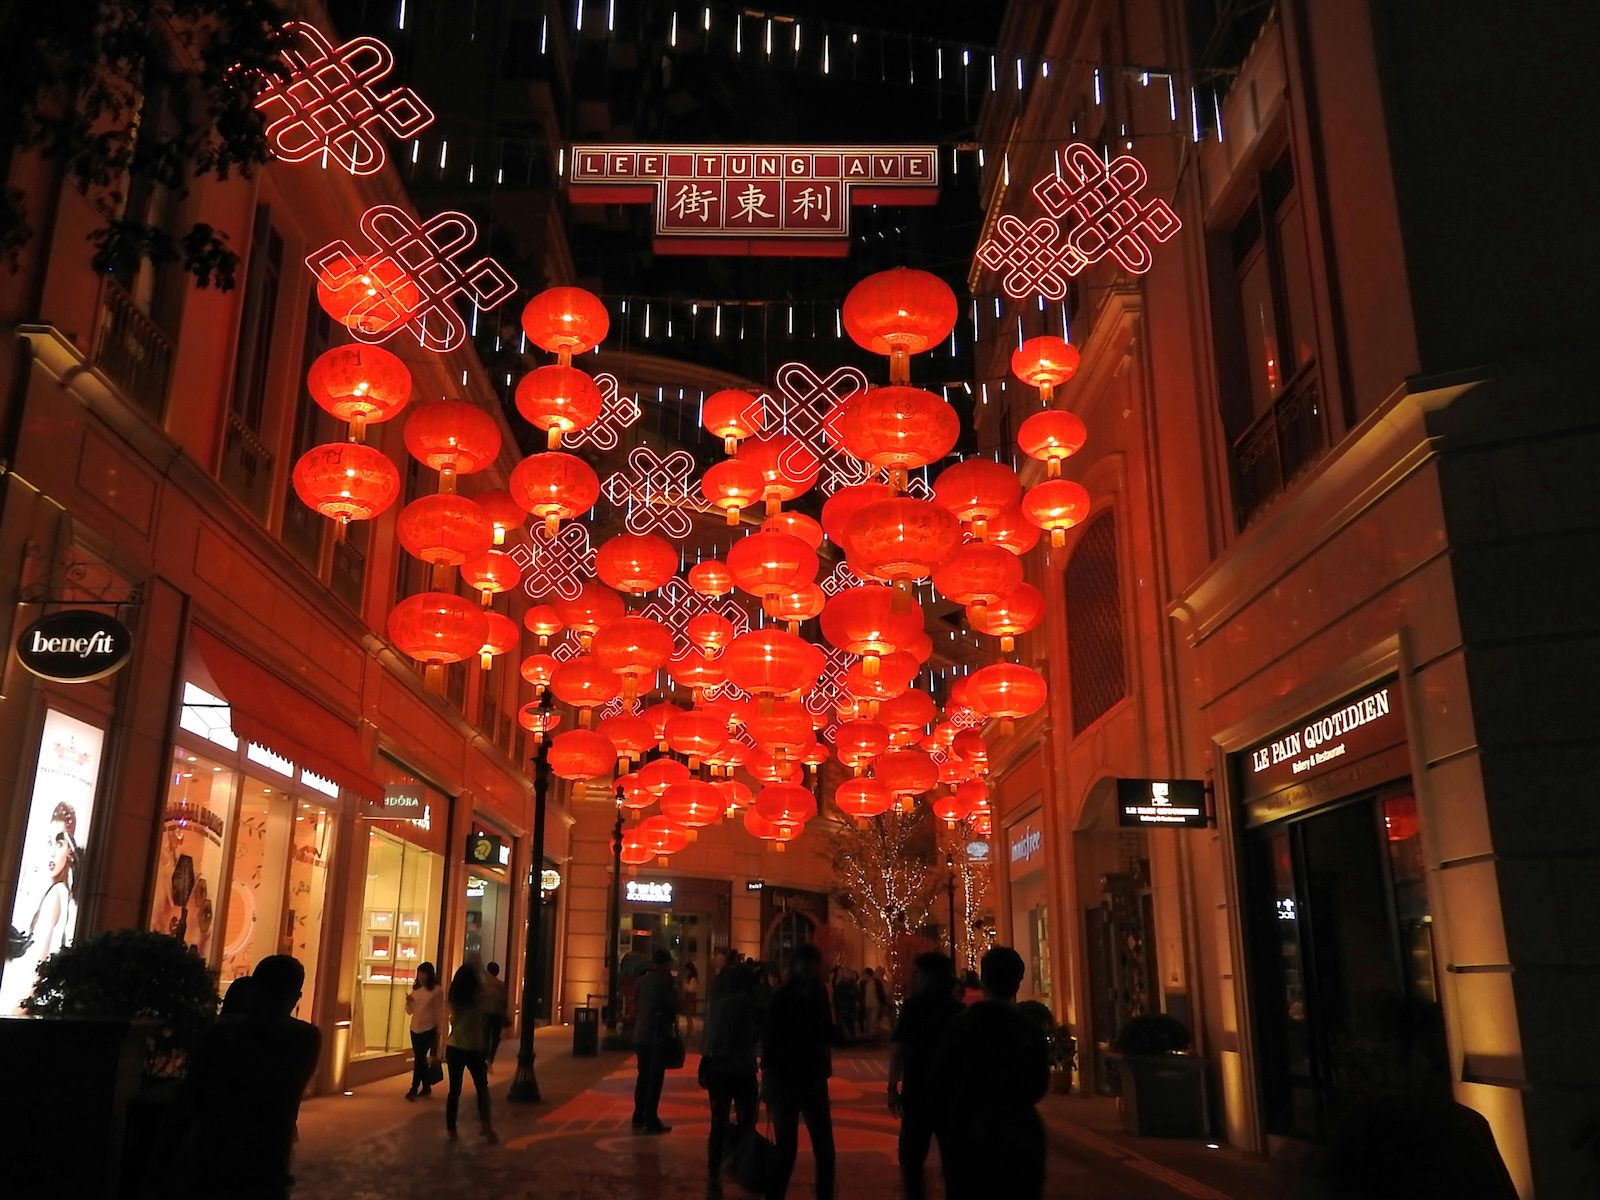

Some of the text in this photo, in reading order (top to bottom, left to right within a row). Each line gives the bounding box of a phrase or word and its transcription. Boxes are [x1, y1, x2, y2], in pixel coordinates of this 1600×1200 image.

[586, 157, 923, 175] LEE TUNG AVE
[31, 630, 115, 659] benefit
[1252, 688, 1391, 773] LE PAIN QUOTIDIEN
